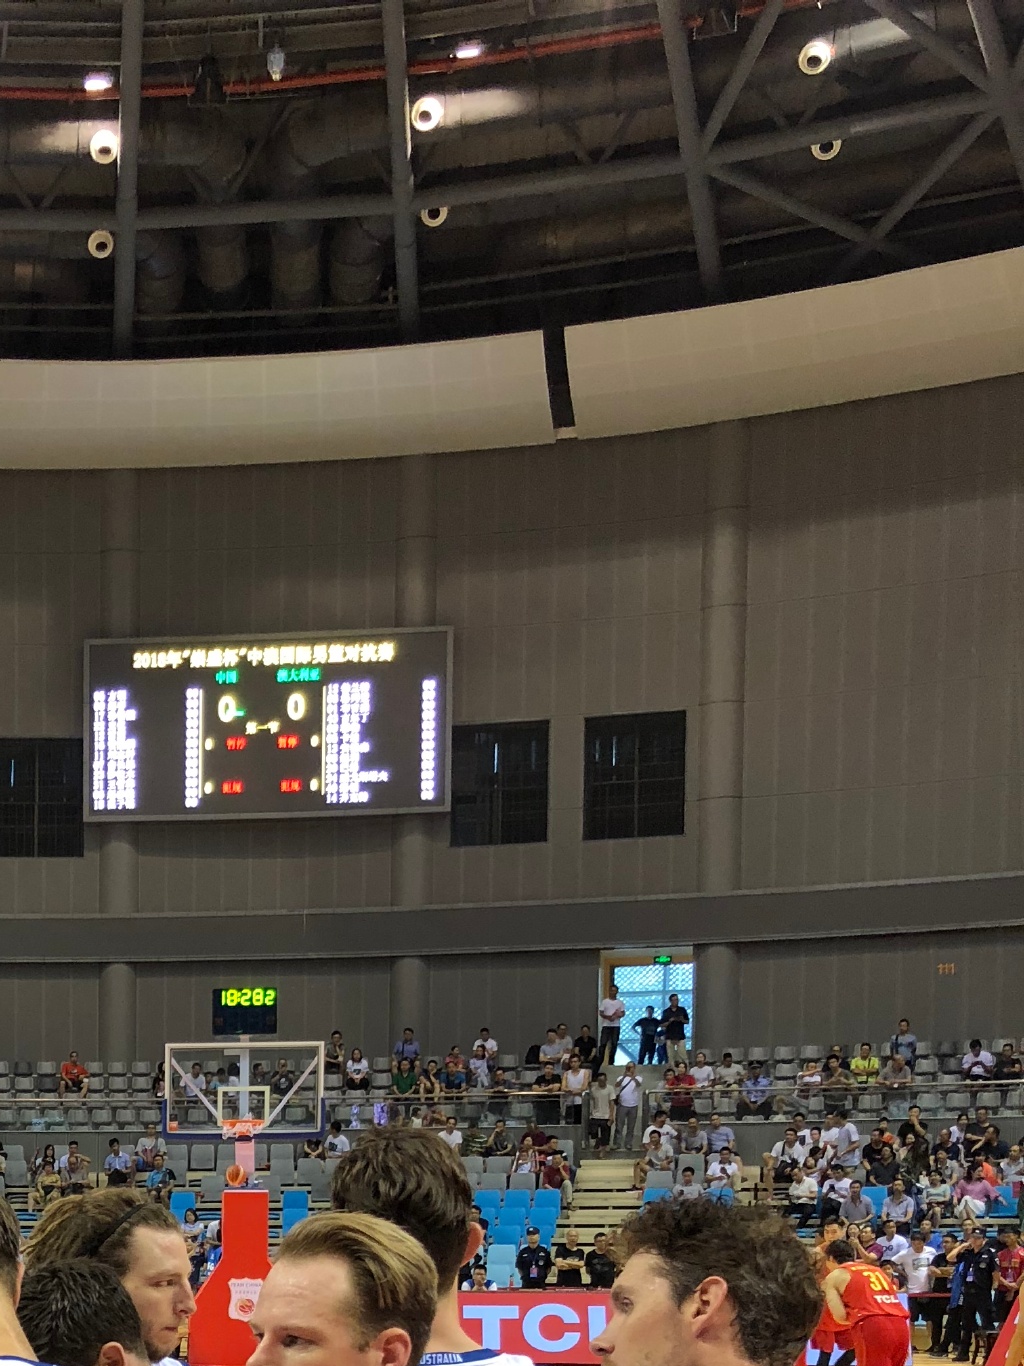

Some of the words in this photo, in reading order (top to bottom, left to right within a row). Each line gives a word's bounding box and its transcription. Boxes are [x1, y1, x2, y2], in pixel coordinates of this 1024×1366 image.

[215, 670, 237, 684] 中国
[277, 668, 320, 682] 澳大利亚
[218, 695, 236, 722] 0
[287, 693, 305, 720] 0
[862, 1271, 890, 1291] 31
[873, 1294, 900, 1304] TCL
